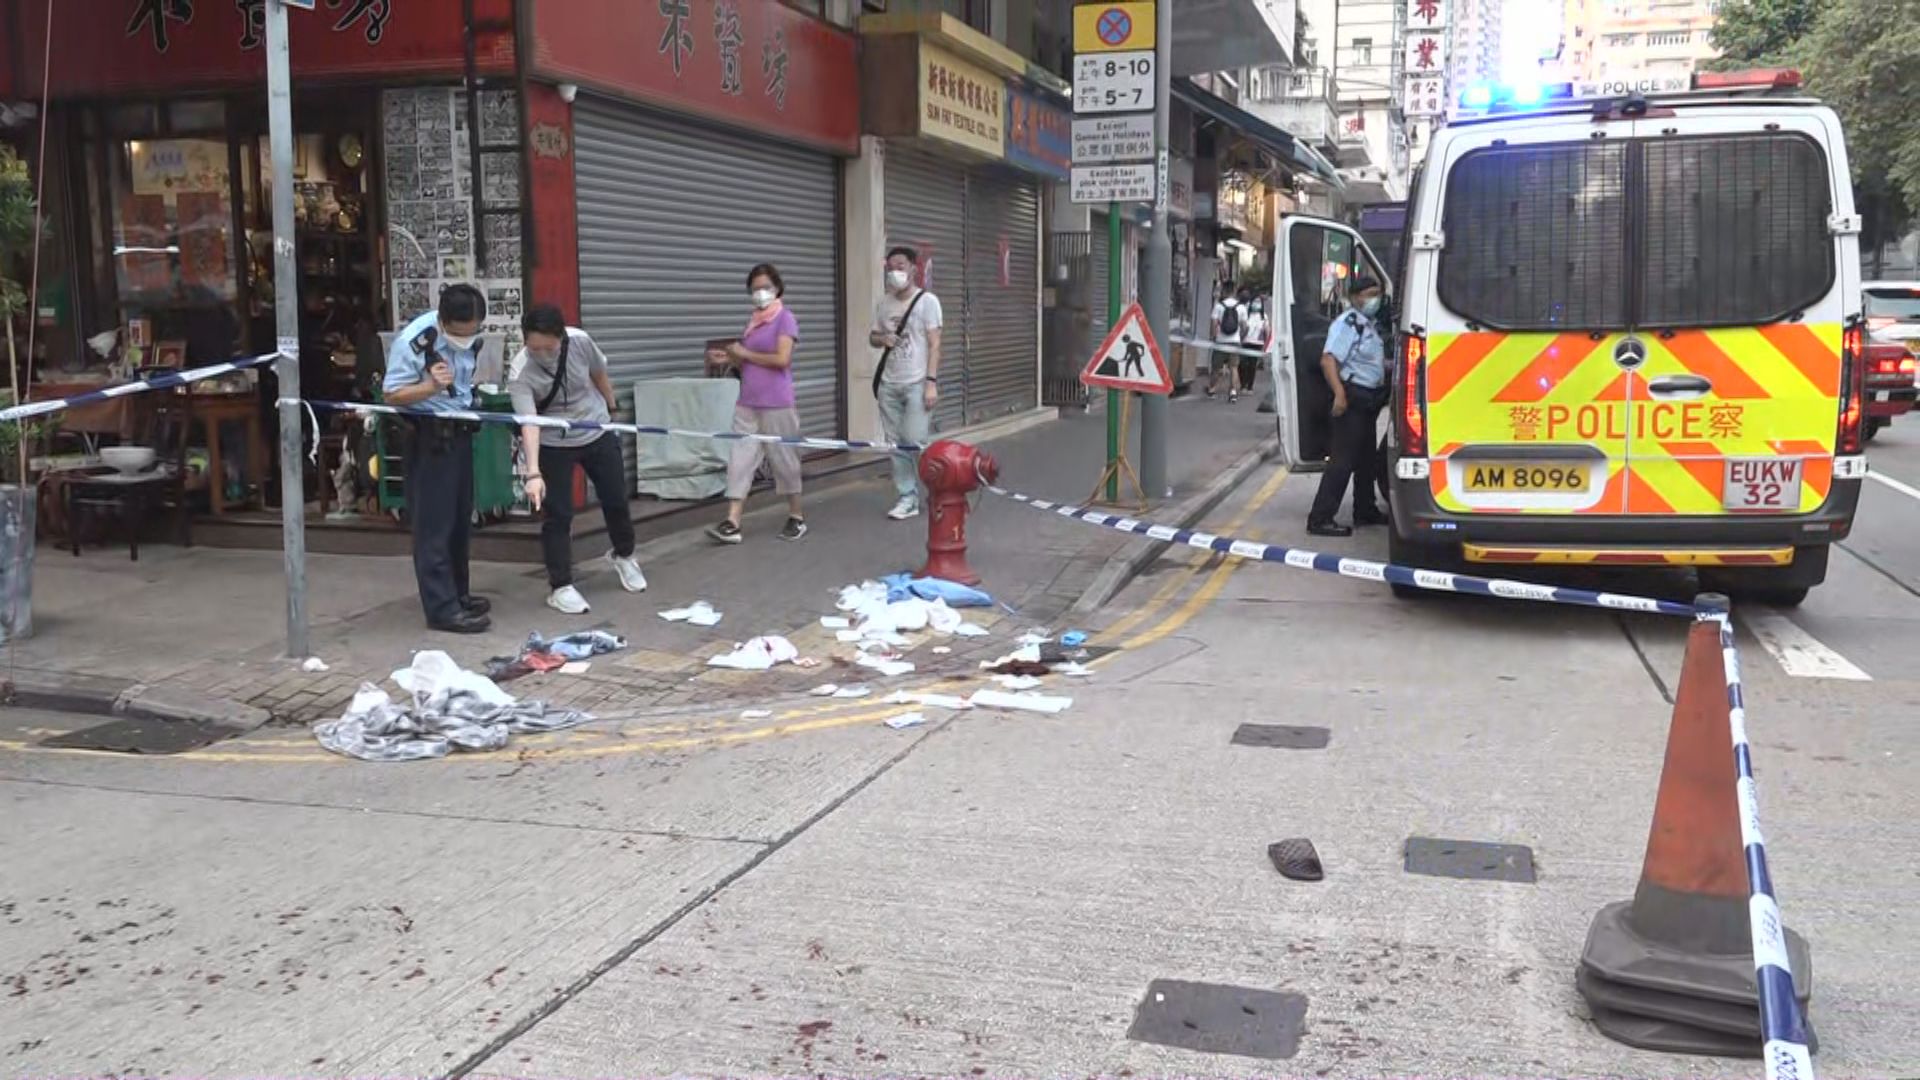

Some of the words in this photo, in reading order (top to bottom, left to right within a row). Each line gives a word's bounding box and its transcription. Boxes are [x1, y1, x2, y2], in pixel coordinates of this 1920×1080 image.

[1078, 68, 1099, 81] 上午
[1105, 58, 1151, 77] 8-10
[1603, 80, 1661, 95] POLICE
[1078, 95, 1099, 107] 下午
[928, 103, 940, 121] SUN
[953, 112, 976, 135] TEXTILE
[1096, 121, 1128, 131] Except
[1075, 132, 1110, 141] General
[1112, 131, 1151, 139] Holidays
[1090, 169, 1118, 178] Except
[1120, 168, 1136, 176] taxi
[1080, 180, 1097, 188] pick
[1472, 468, 1504, 488] AM
[1513, 468, 1582, 488] 8096
[1730, 461, 1796, 482] EUKW
[1743, 484, 1782, 505] 32
